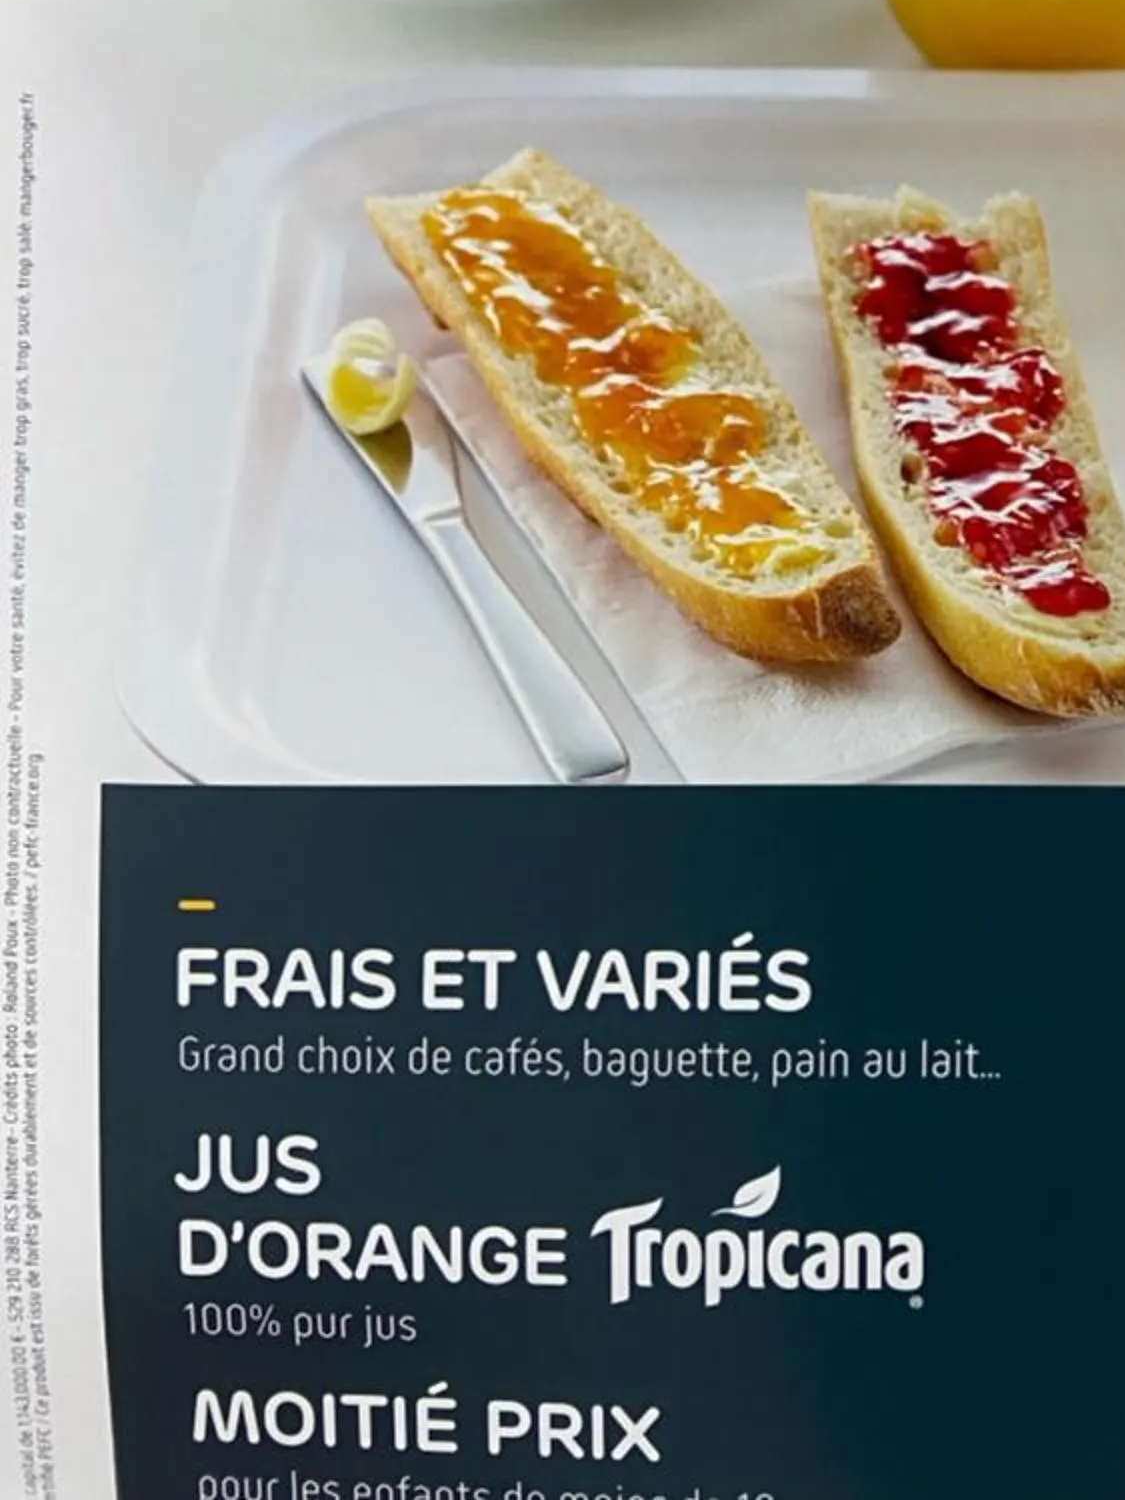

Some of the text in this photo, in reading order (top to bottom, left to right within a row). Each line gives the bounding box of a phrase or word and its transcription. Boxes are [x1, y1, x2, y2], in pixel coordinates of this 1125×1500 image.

[17, 92, 38, 216] mangerbouger.fr
[16, 258, 33, 289] trop
[15, 341, 32, 371] trop
[13, 415, 31, 447] trop
[13, 451, 31, 508] manger
[12, 511, 26, 530] de
[11, 534, 26, 580] évitez
[10, 633, 24, 673] votre
[7, 677, 23, 711] Pour
[7, 725, 22, 825] contractuelle
[8, 829, 20, 858] non
[4, 862, 19, 907] Photo
[2, 962, 18, 1013] Roland
[177, 931, 811, 1012] FRAIS ET VARIÉS
[24, 968, 38, 1026] sources
[3, 1025, 20, 1068] photo
[22, 1030, 37, 1049] de
[179, 1035, 284, 1073] Grand
[298, 1035, 395, 1074] choix
[408, 1037, 451, 1075] de
[465, 1037, 570, 1080] cafés,
[583, 1038, 759, 1087] baguette,
[772, 1039, 849, 1088] pain
[863, 1049, 906, 1078] au
[2, 1072, 18, 1124] Crédits
[22, 1072, 38, 1167] durablement
[4, 1137, 19, 1200] Nanterre
[174, 1133, 321, 1195] JUS
[4, 1205, 19, 1232] RCS
[23, 1224, 40, 1266] forêts
[587, 1195, 924, 1307] Tropicana
[6, 1268, 22, 1292] 210
[25, 1270, 41, 1288] de
[7, 1296, 23, 1322] 529
[27, 1291, 42, 1319] issu
[184, 1302, 417, 1348] 100% pur jus
[30, 1323, 44, 1344] est
[193, 1381, 660, 1462] MOITIÉ PRIX
[198, 1475, 278, 1500] pour
[291, 1470, 340, 1500] les
